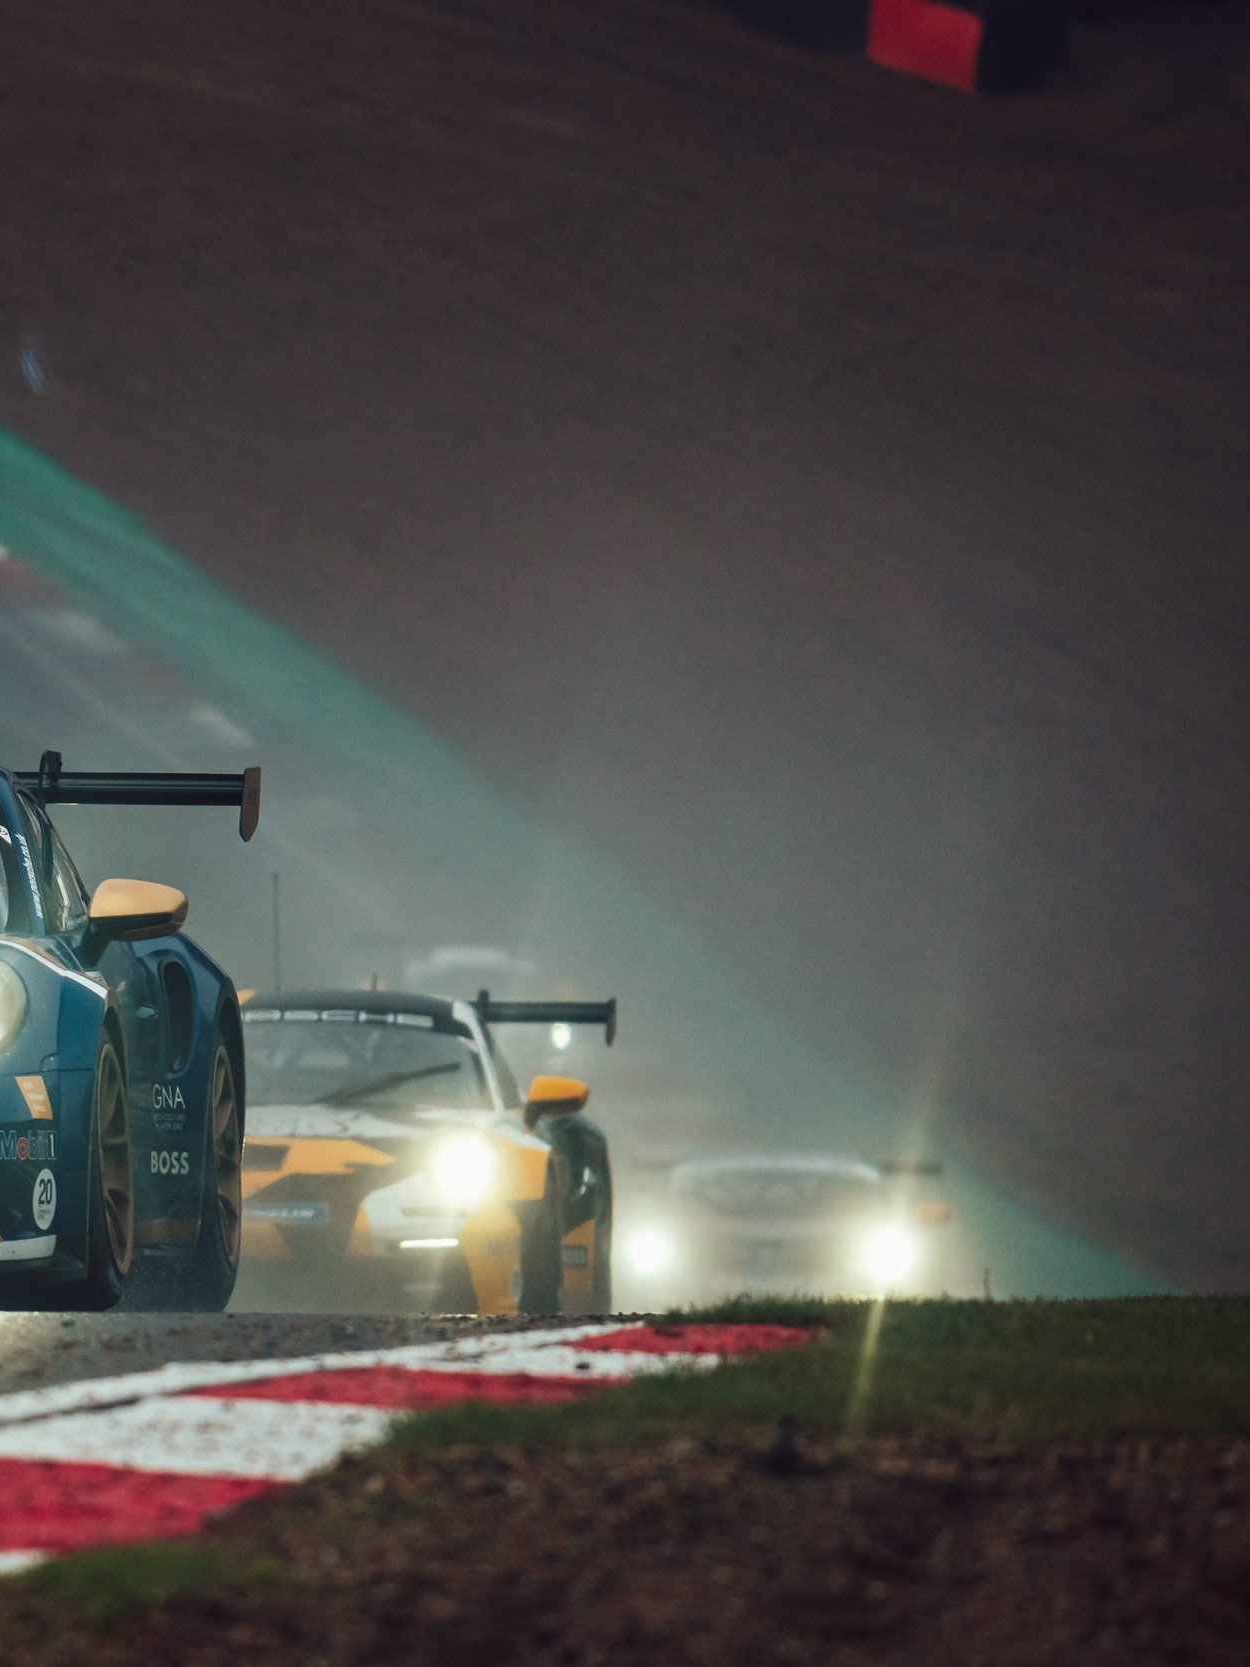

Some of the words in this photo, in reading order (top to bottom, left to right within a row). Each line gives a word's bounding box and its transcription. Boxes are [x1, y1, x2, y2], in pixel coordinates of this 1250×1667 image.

[152, 1083, 186, 1109] GNA
[150, 1150, 189, 1175] BOSS
[38, 1178, 53, 1205] 20
